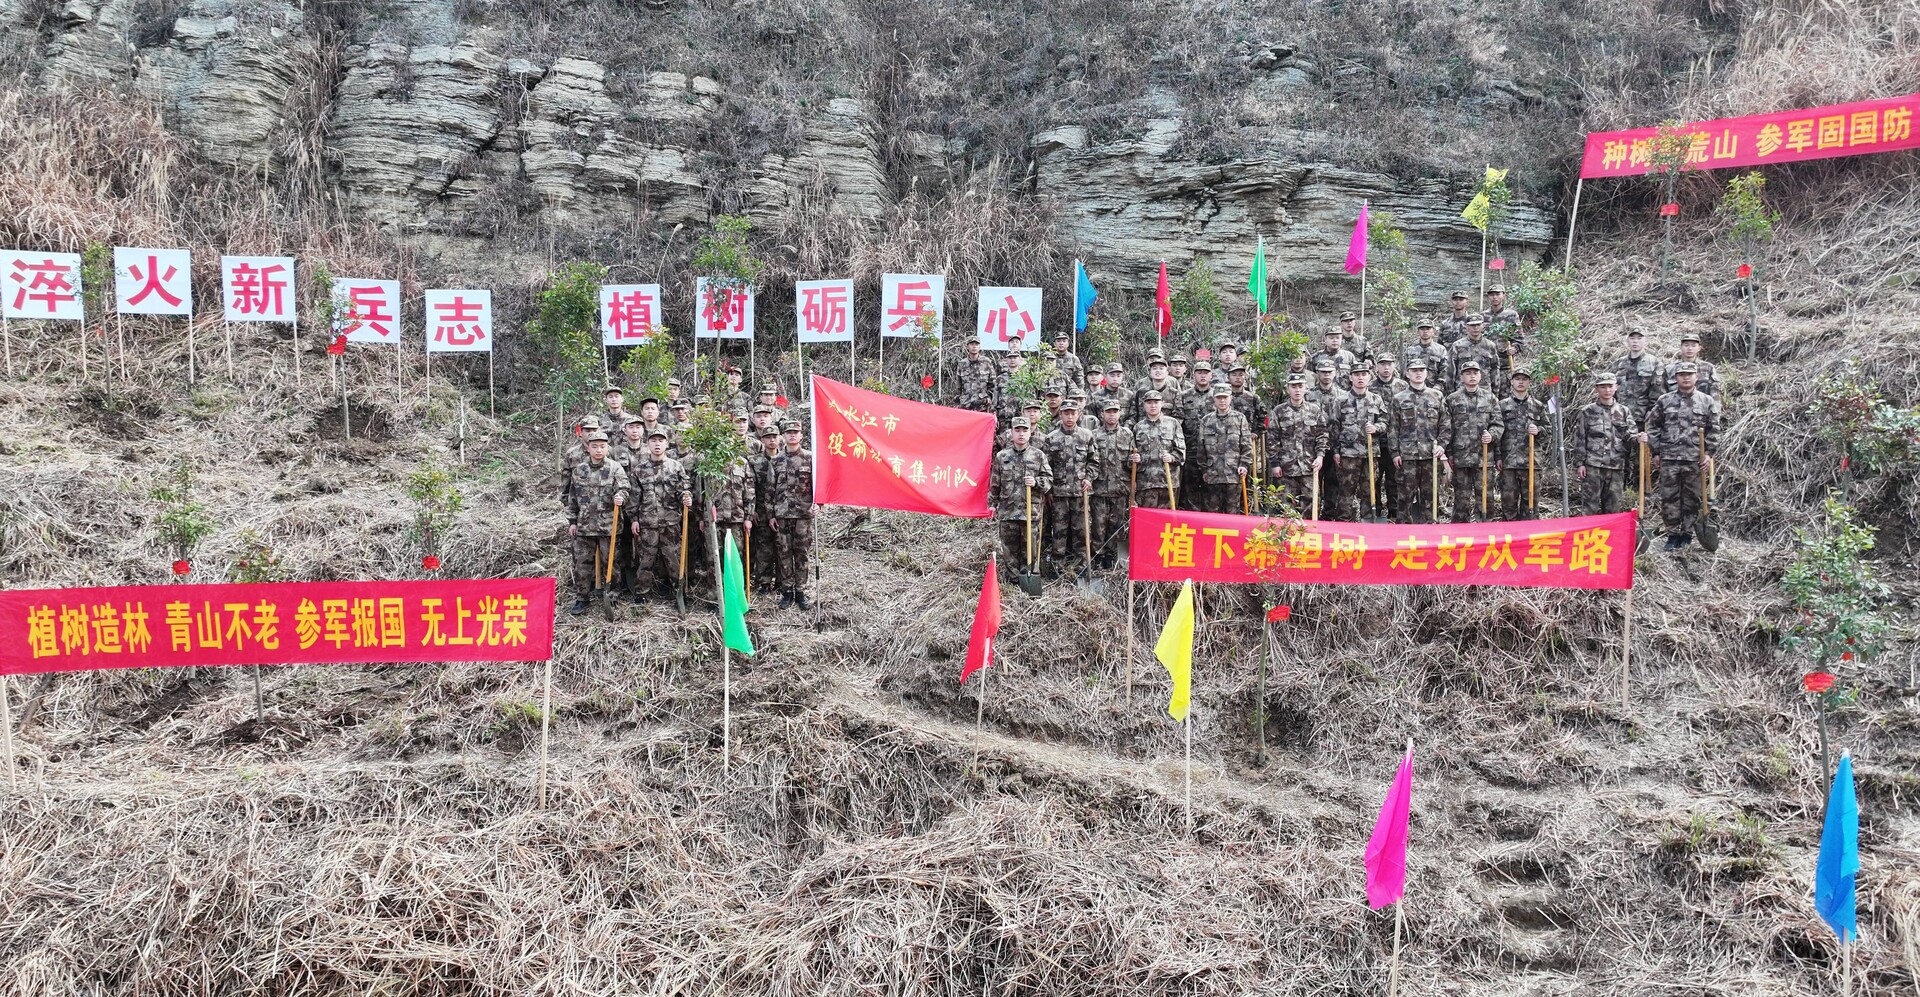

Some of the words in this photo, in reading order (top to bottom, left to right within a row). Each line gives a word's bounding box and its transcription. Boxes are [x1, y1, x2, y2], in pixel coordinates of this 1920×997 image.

[1602, 129, 1738, 170] 种树荒山
[1755, 106, 1913, 157] 参军固国防
[9, 258, 78, 313] 淬
[126, 255, 183, 308] 火
[230, 262, 289, 316] 新
[887, 281, 936, 332] 兵
[340, 285, 393, 337] 兵
[433, 296, 486, 346] 志
[607, 290, 654, 340] 植
[701, 284, 749, 333] 树
[801, 286, 847, 335] 砺
[984, 294, 1036, 343] 心
[1158, 522, 1369, 570] 植下希望树
[1389, 528, 1613, 575] 走好从军路
[27, 601, 152, 659] 植树造林
[165, 599, 280, 653] 青山不老
[294, 596, 406, 650] 参军报国
[420, 594, 529, 647] 无上光荣
